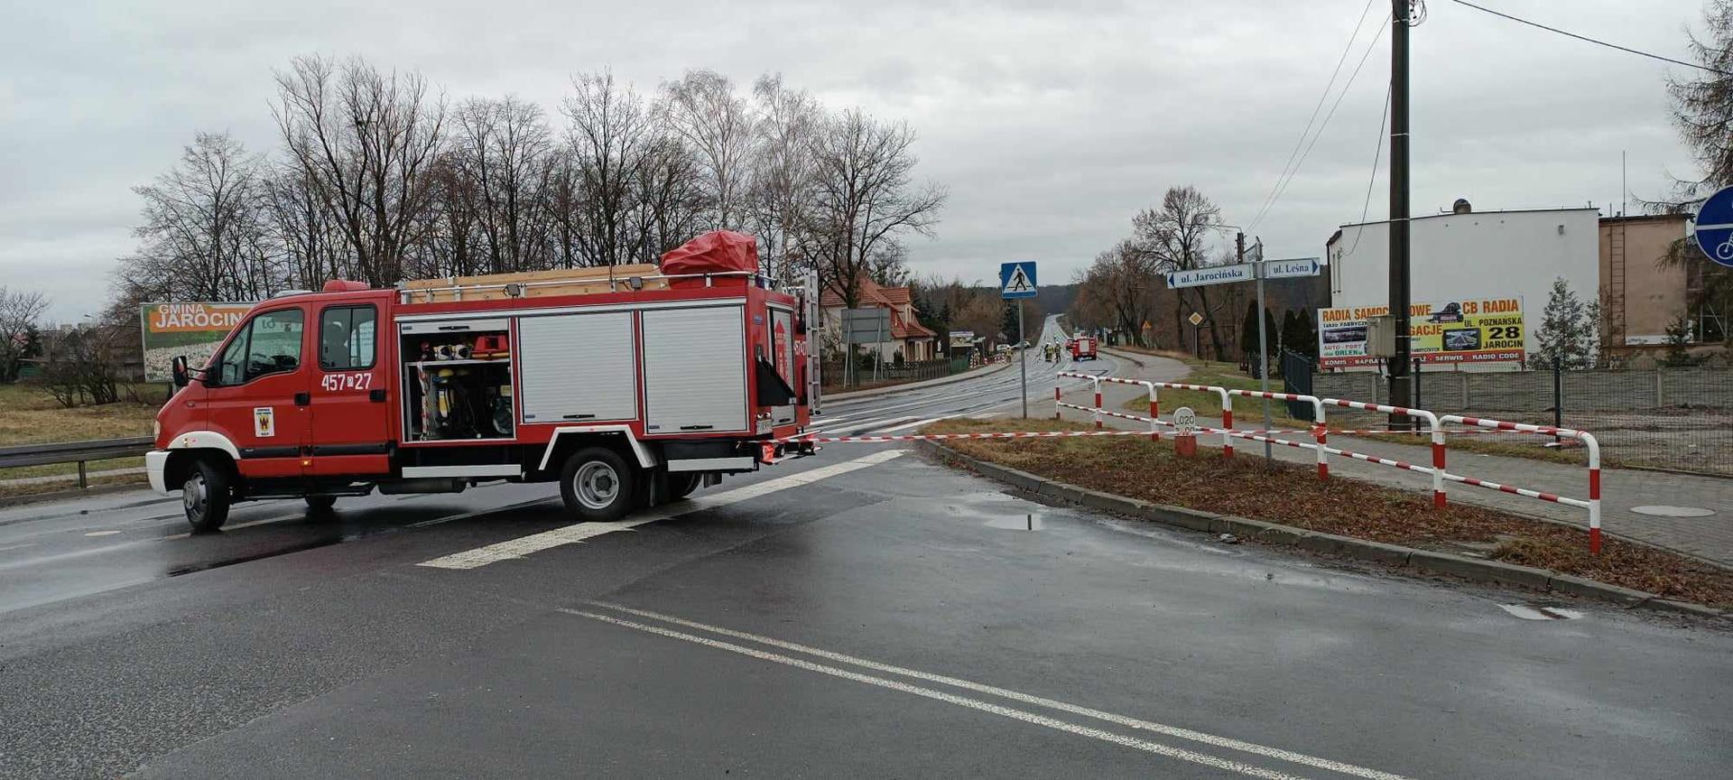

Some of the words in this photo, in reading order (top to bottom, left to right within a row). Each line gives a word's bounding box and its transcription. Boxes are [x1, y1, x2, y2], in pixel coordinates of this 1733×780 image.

[1273, 264, 1284, 273] ul.
[1285, 263, 1309, 273] Leśna
[1181, 274, 1192, 283] ul.
[1195, 269, 1243, 282] Jarocińska
[158, 303, 205, 315] GMINA
[1322, 309, 1351, 322] RADIA
[1462, 301, 1478, 315] CB
[1483, 299, 1519, 313] RADIA
[156, 312, 245, 328] JAROCIN
[1464, 319, 1475, 328] UL.
[1488, 326, 1520, 340] 28
[1483, 340, 1523, 349] JAROCIN
[321, 374, 346, 391] 457
[355, 373, 372, 390] 27
